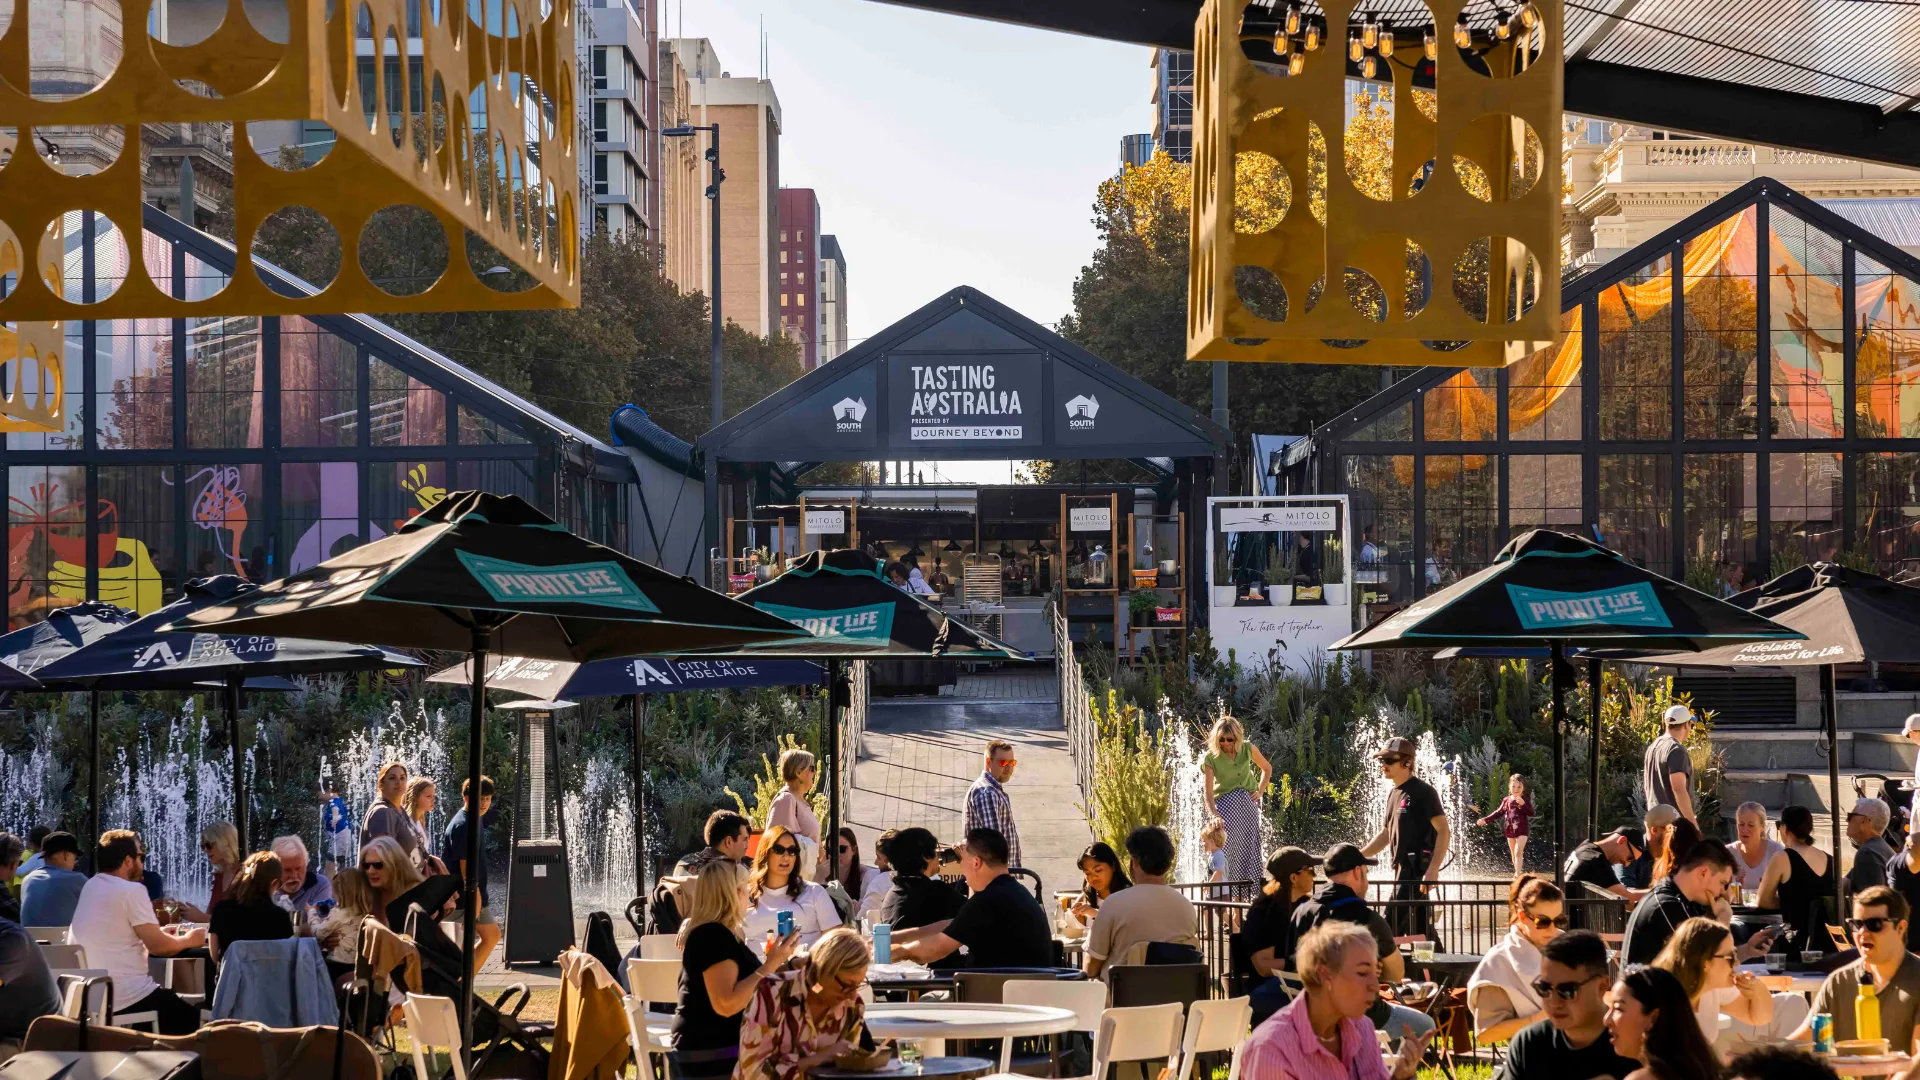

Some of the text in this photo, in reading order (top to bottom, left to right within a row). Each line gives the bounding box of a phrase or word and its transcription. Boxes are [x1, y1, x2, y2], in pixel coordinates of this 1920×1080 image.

[911, 365, 995, 389] TASTING
[913, 428, 1020, 438] JOURNEY BEYOND
[1285, 512, 1330, 520] MITOLO
[1239, 617, 1257, 635] The
[1258, 620, 1276, 633] taste
[1277, 621, 1286, 634] of
[202, 636, 270, 650] CITY OF
[200, 642, 288, 659] ADELAIDE
[1732, 652, 1798, 662] Designed
[1797, 649, 1819, 660] for
[678, 660, 734, 672] CITY OF
[685, 666, 759, 680] ADELAIDE
